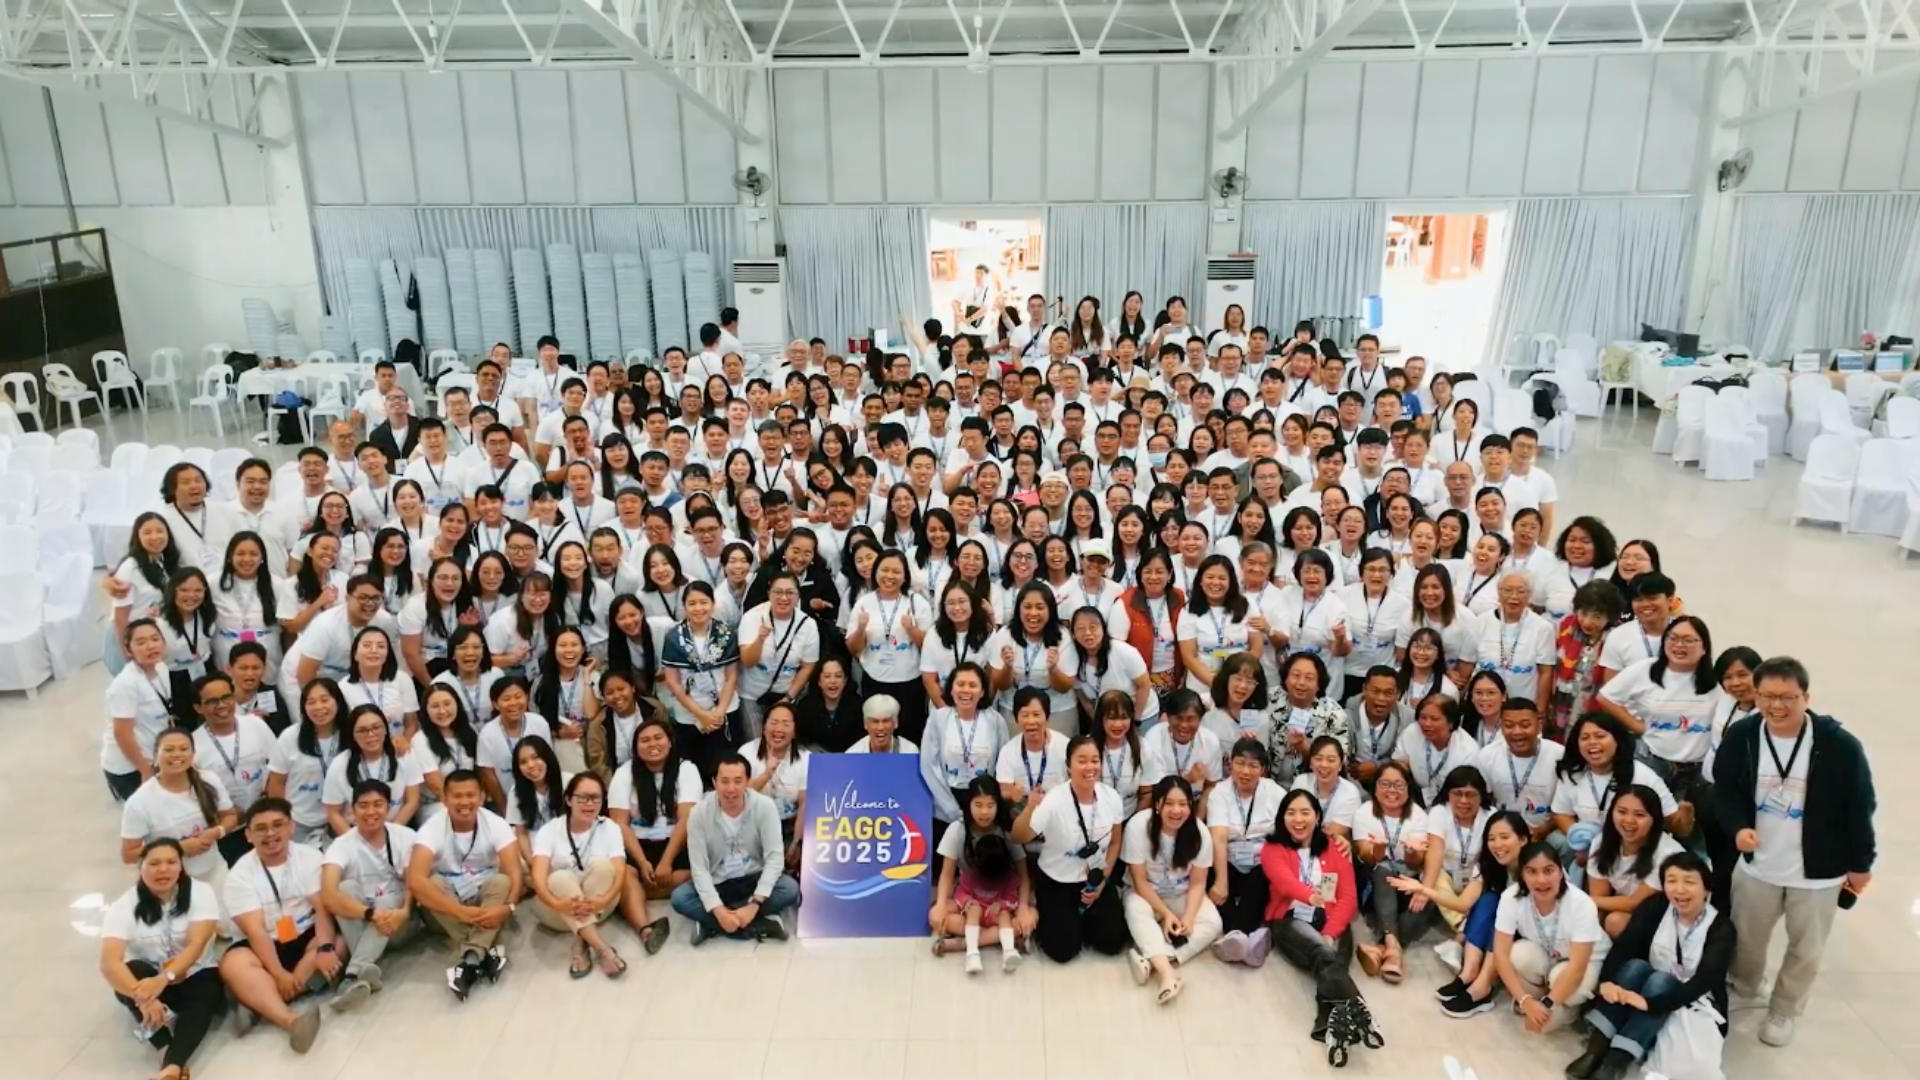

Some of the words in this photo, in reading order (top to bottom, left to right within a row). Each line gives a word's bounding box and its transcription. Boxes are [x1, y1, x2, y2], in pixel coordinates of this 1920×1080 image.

[824, 779, 886, 819] Welcome
[887, 797, 900, 809] to
[815, 816, 892, 841] EAGC
[815, 842, 891, 863] 2025
